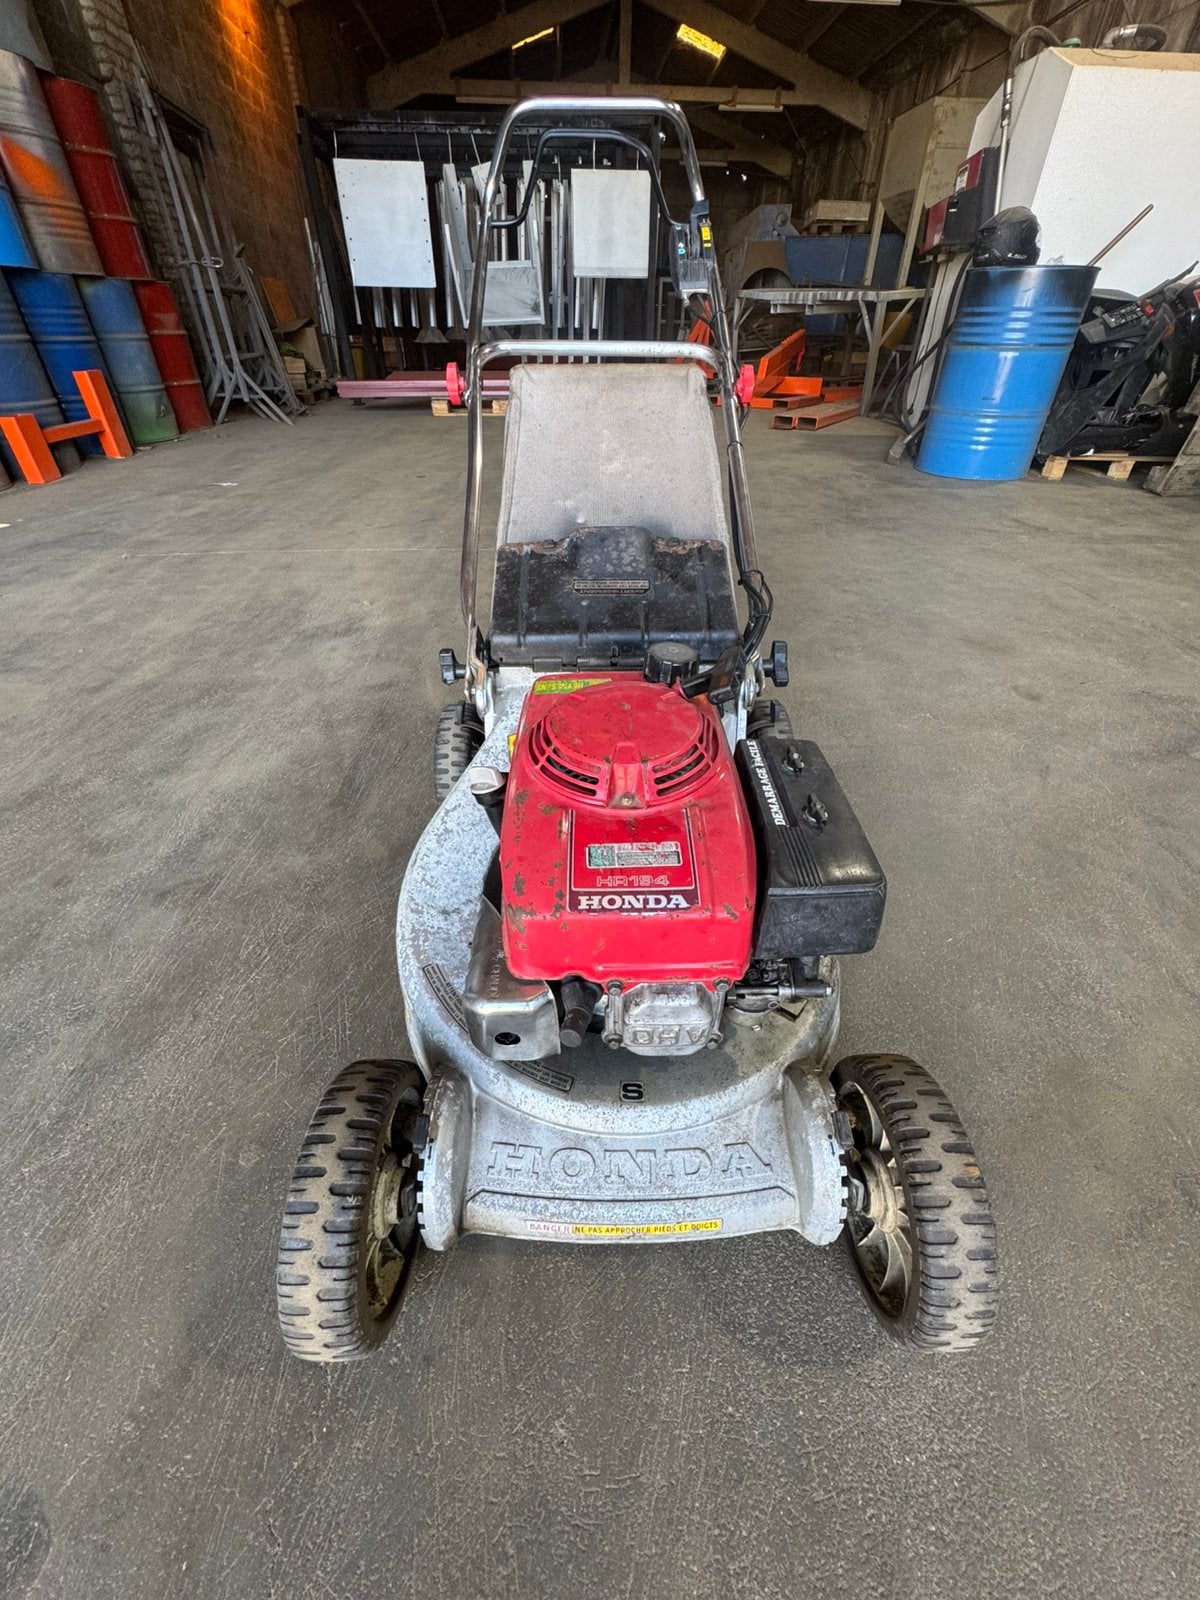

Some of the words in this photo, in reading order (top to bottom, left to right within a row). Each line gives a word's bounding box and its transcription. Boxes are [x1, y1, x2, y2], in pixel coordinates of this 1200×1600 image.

[746, 740, 765, 767] FACILE
[756, 767, 786, 826] DEMARRAGE
[578, 895, 690, 909] HONDA
[632, 1026, 708, 1045] OHV
[622, 1083, 644, 1100] S
[487, 1141, 773, 1186] HONDA
[529, 1223, 570, 1233] DANGER
[574, 1226, 584, 1234] NE
[588, 1226, 603, 1234] PAS
[605, 1226, 651, 1234] APPROCHER
[654, 1225, 675, 1233] PIEDS
[691, 1221, 719, 1231] DOIGTS
